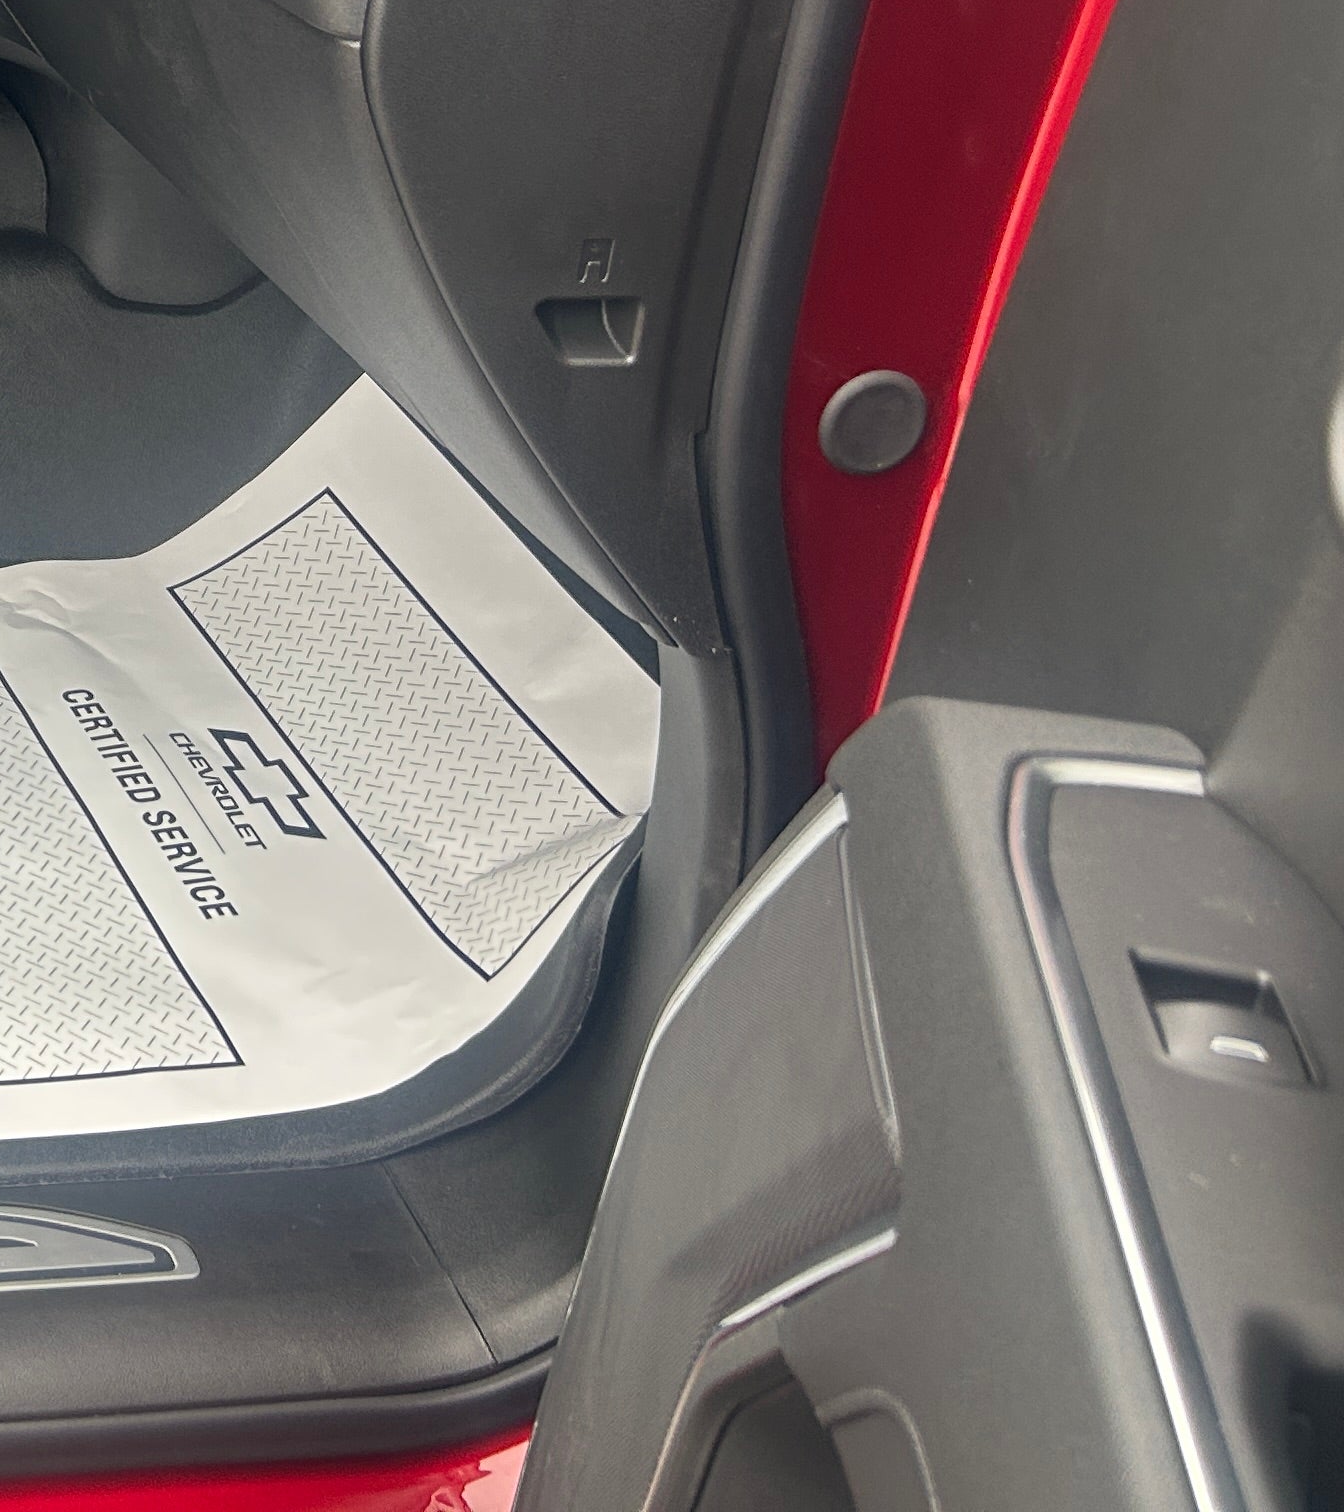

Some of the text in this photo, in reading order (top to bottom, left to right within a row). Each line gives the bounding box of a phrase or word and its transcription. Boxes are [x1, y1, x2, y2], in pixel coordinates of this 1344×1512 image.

[62, 688, 238, 920] CERTIFIED SERVICE
[169, 732, 267, 850] CHEVROLET
